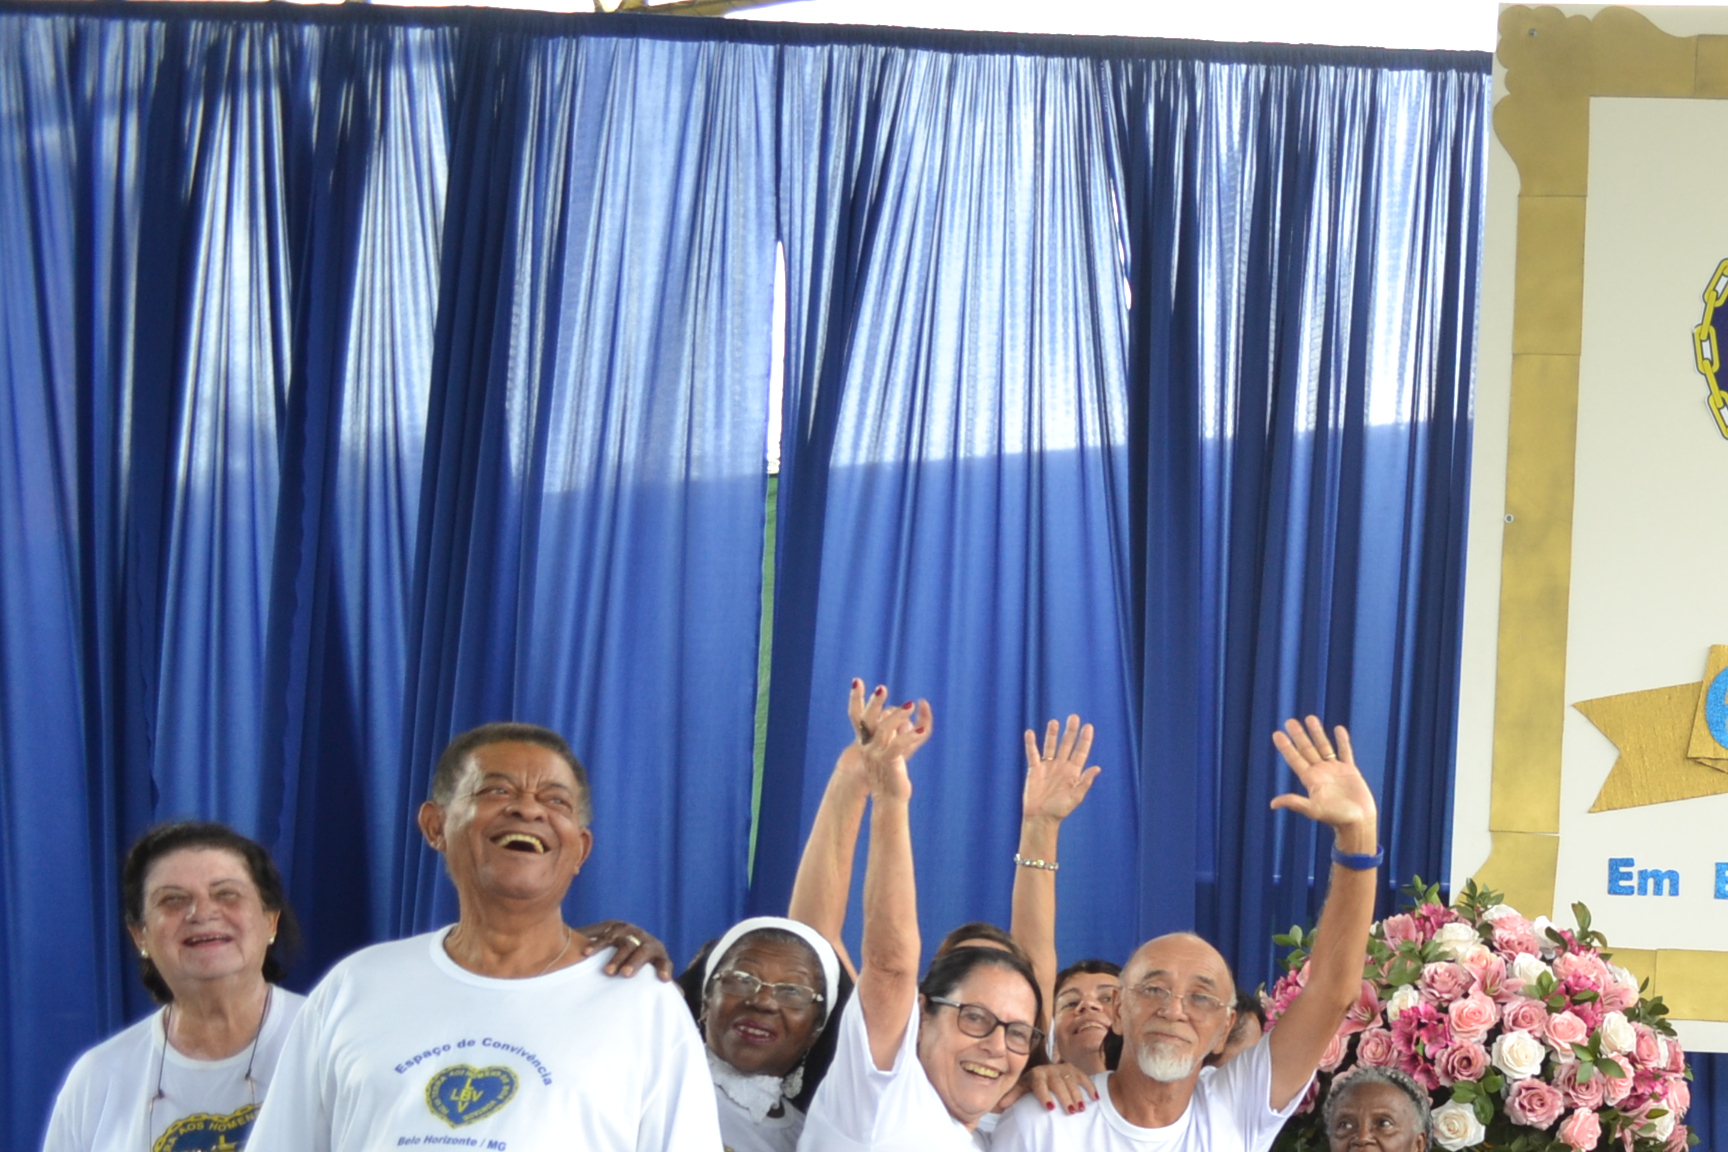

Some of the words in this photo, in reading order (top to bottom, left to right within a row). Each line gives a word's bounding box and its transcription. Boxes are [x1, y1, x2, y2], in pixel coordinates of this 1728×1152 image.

[1607, 857, 1680, 897] Em
[394, 1043, 451, 1075] Espaço
[457, 1038, 476, 1049] de
[178, 1122, 204, 1135] AOS
[208, 1112, 256, 1131] HOMEN
[397, 1135, 421, 1147] Belo
[423, 1135, 477, 1148] Horizonte
[486, 1139, 507, 1152] MG
